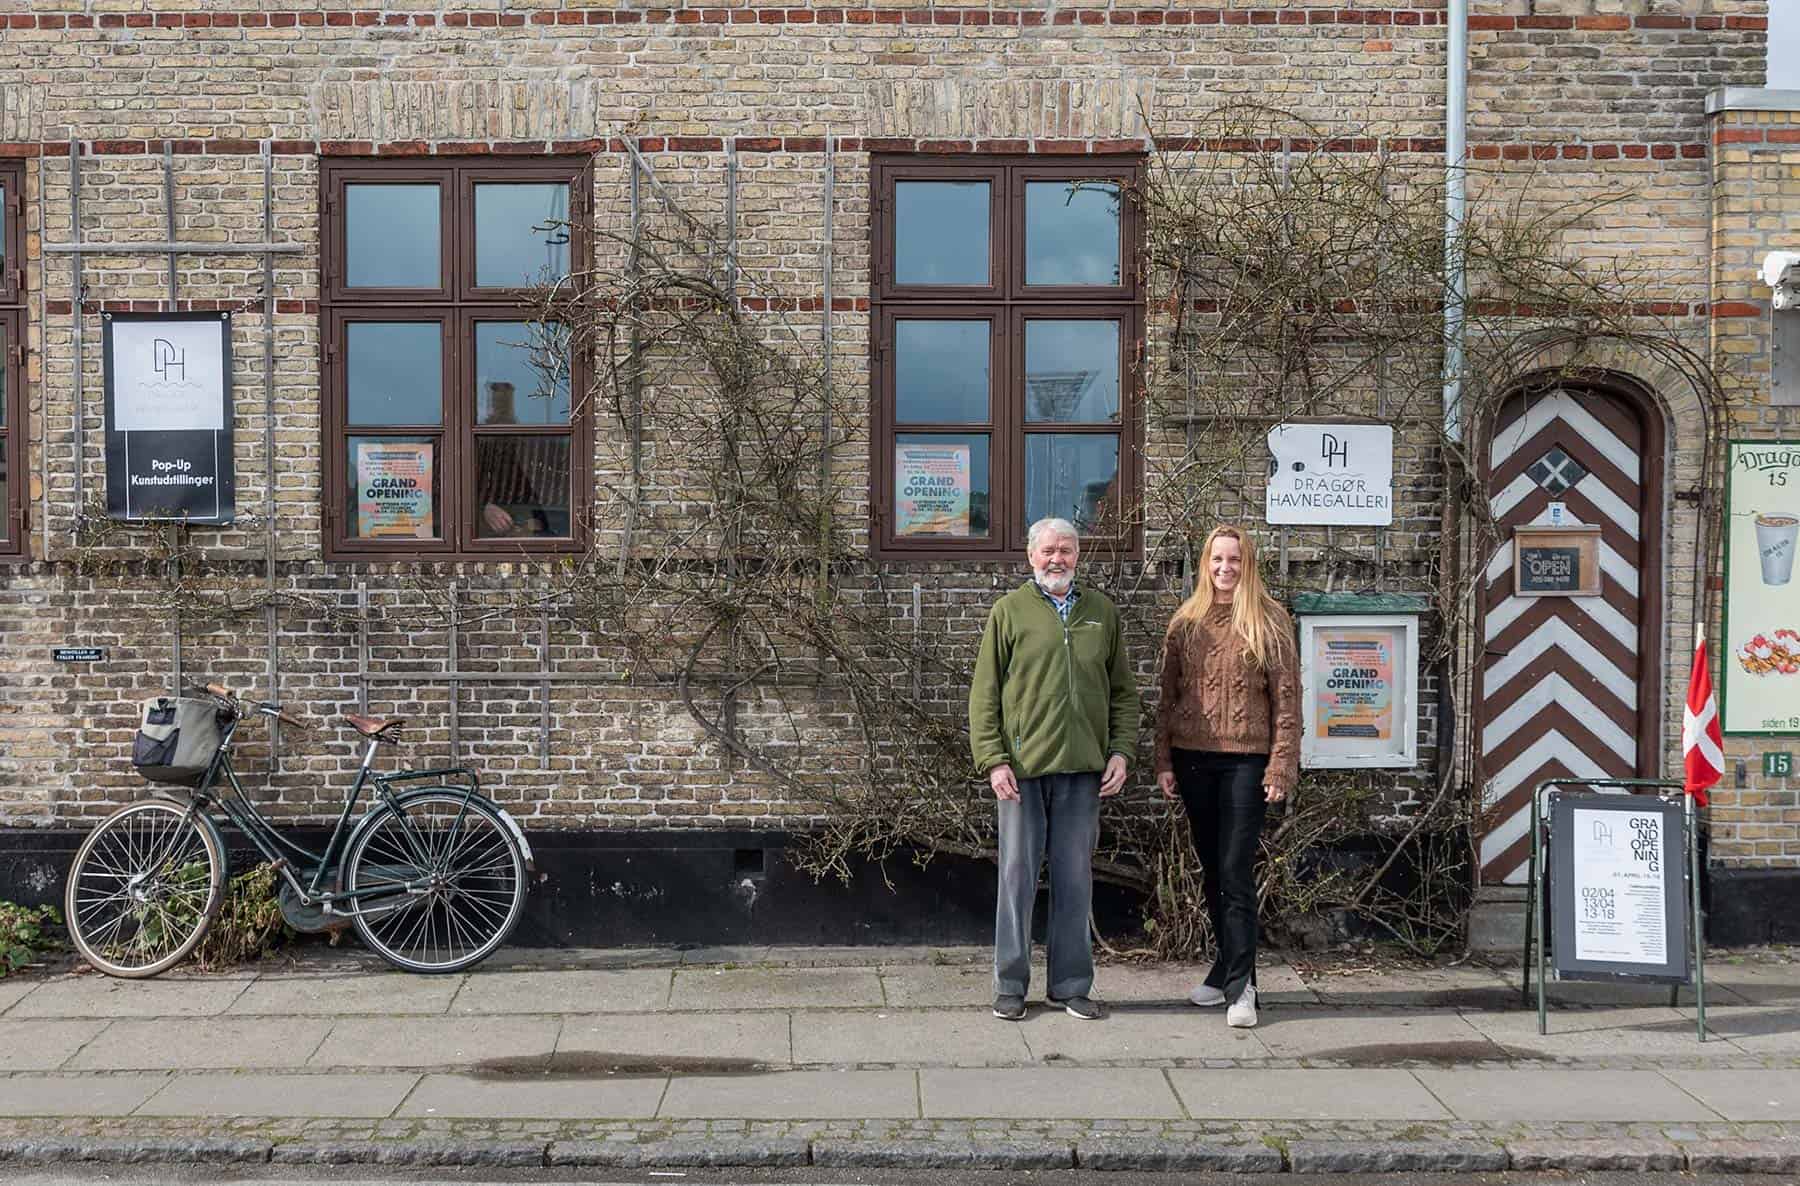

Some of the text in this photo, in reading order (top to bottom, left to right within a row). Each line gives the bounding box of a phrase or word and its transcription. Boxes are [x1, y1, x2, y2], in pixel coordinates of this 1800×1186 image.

[151, 459, 191, 472] Pop-Up
[131, 474, 214, 487] Kunstudstillinger
[372, 478, 417, 488] GRAND
[910, 476, 954, 486] GRAND
[1769, 472, 1787, 486] 15
[1294, 478, 1367, 492] DRAGØR
[366, 489, 423, 499] OPENING
[903, 486, 961, 497] OPENING
[1270, 493, 1388, 508] HAVNEGALLERI
[1530, 560, 1571, 576] OPEN
[1332, 668, 1379, 679] GRAND
[1326, 679, 1384, 689] OPENING
[1769, 755, 1789, 773] 15
[1629, 818, 1658, 829] GRA
[1638, 829, 1658, 840] ND
[1630, 839, 1658, 850] OPE
[1634, 850, 1658, 861] NIN
[1648, 861, 1659, 872] G
